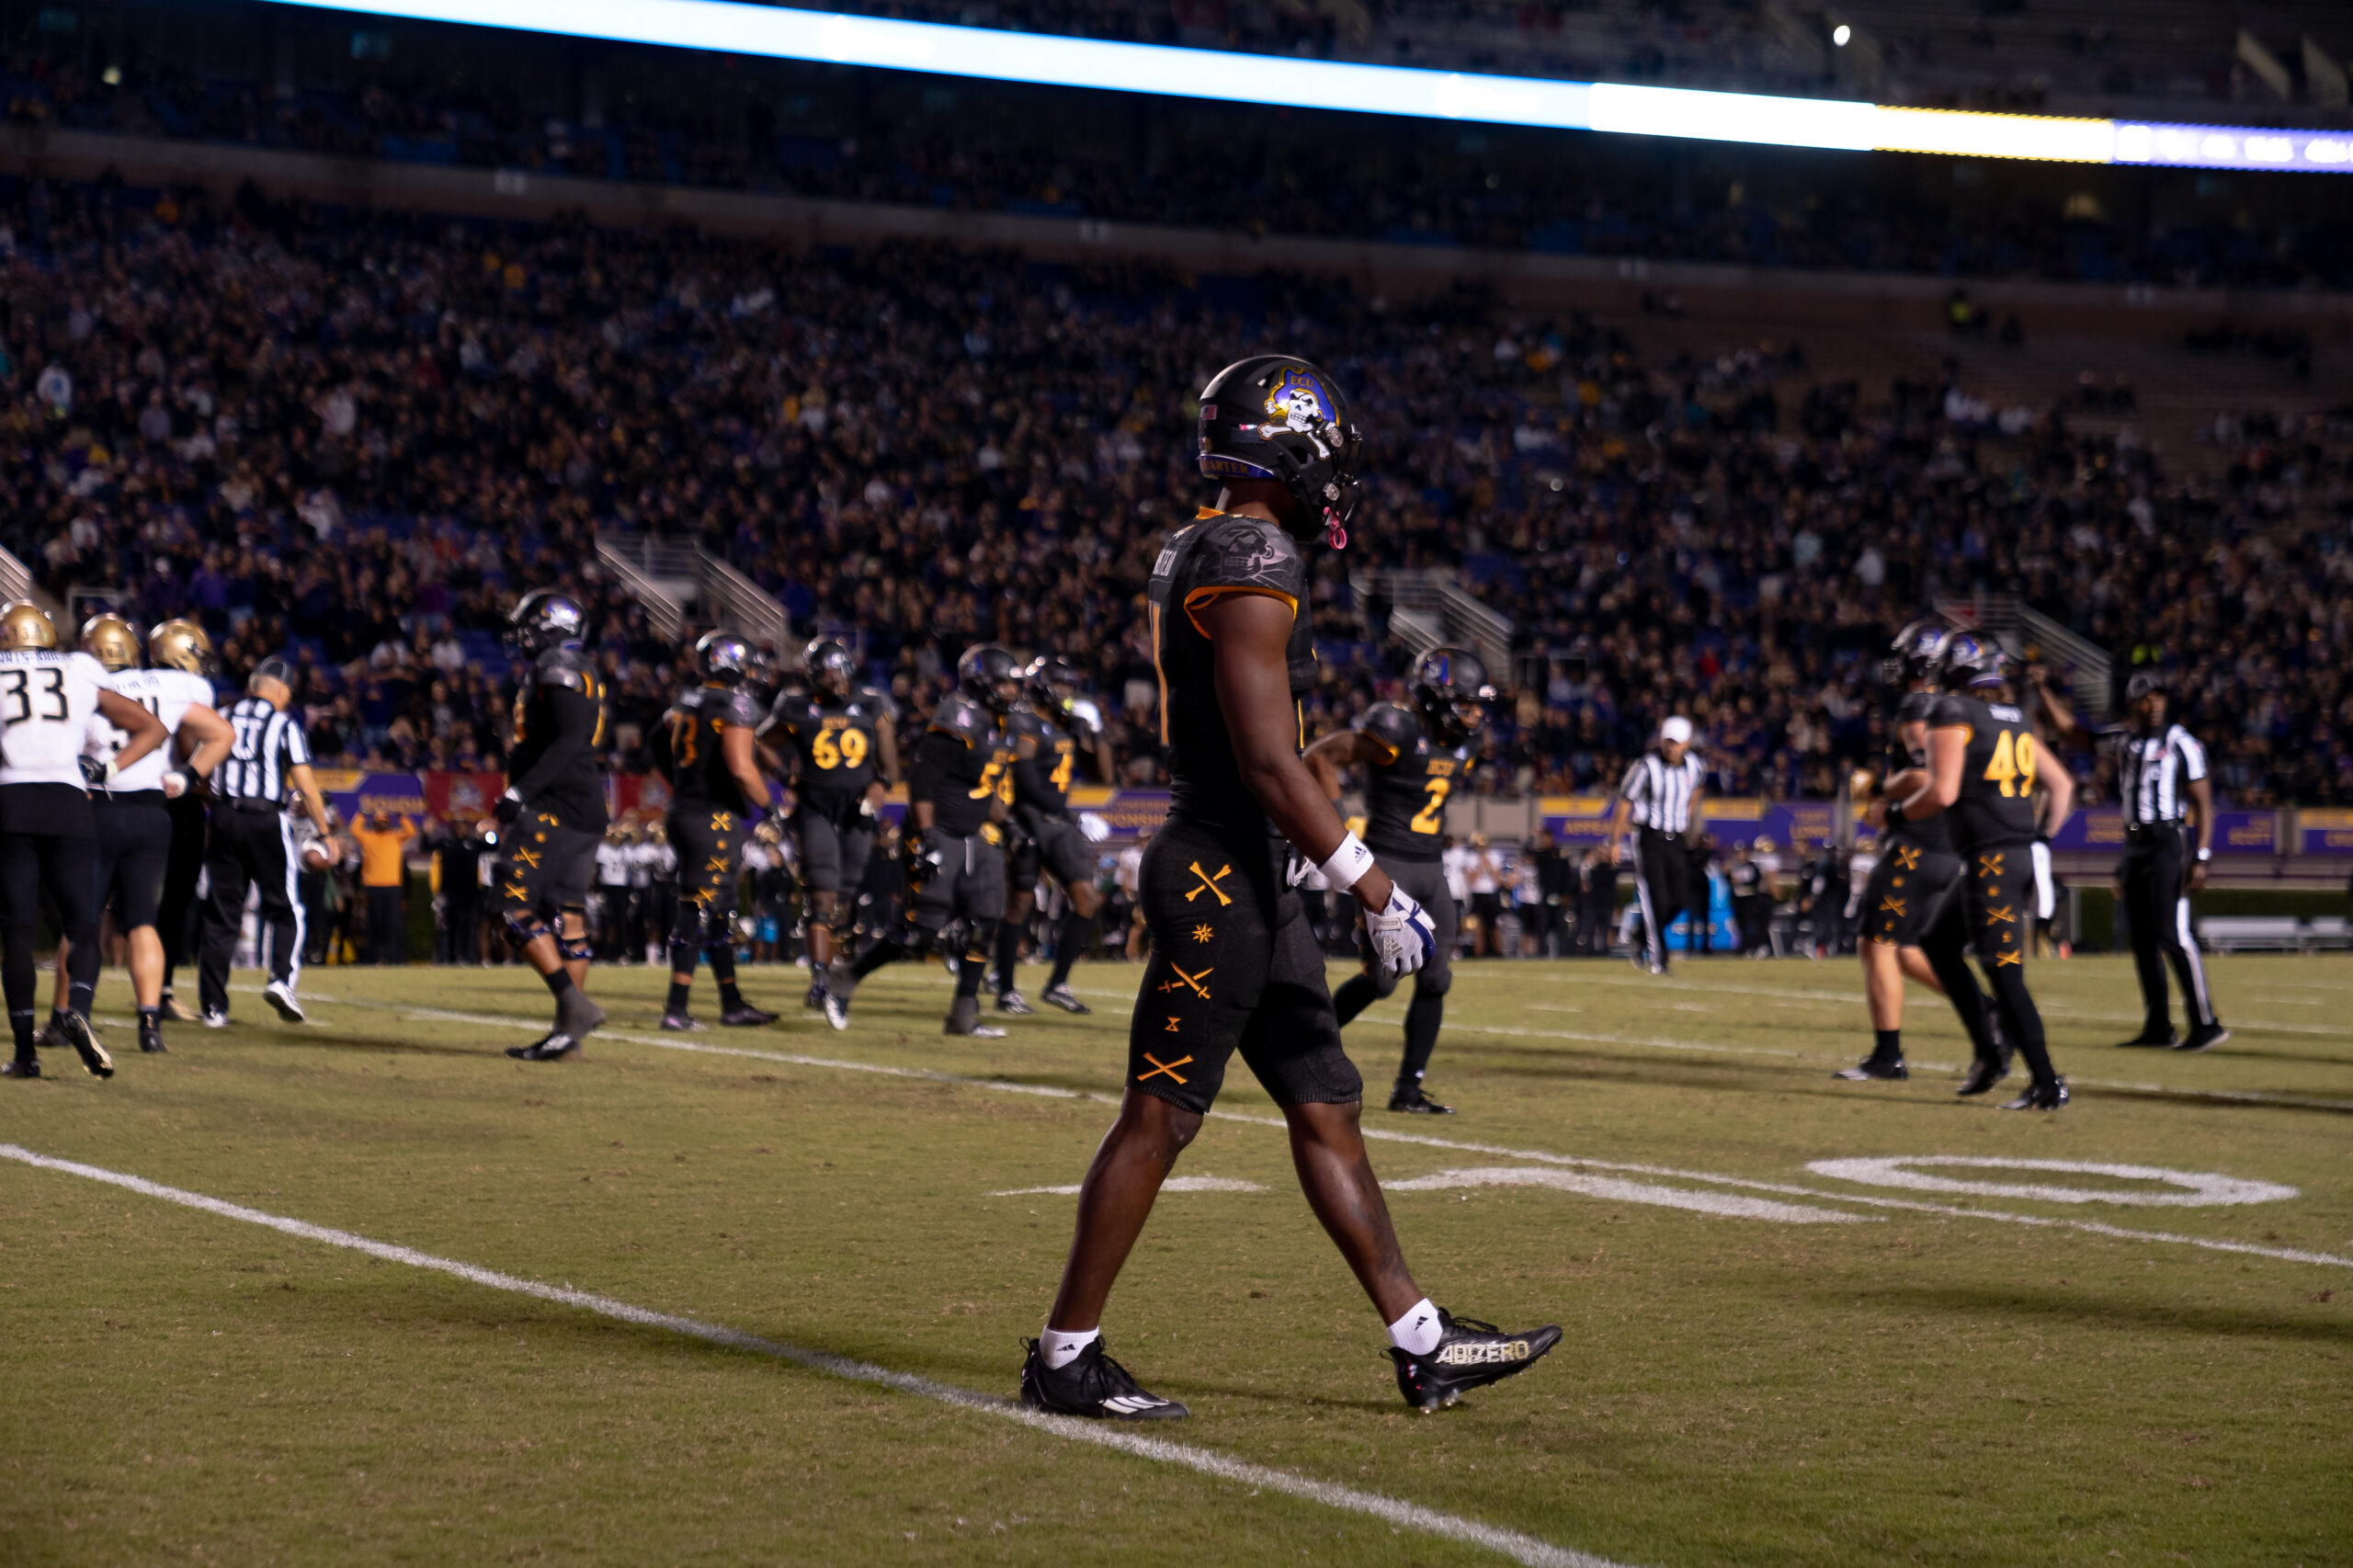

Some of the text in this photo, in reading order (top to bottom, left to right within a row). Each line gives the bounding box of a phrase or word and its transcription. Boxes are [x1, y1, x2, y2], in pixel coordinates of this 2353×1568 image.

[1290, 376, 1314, 388] ECU
[0, 668, 68, 727] 33
[812, 727, 869, 770] 69
[1049, 753, 1074, 794] 4
[1983, 729, 2037, 798] 49
[1410, 777, 1450, 835] 2
